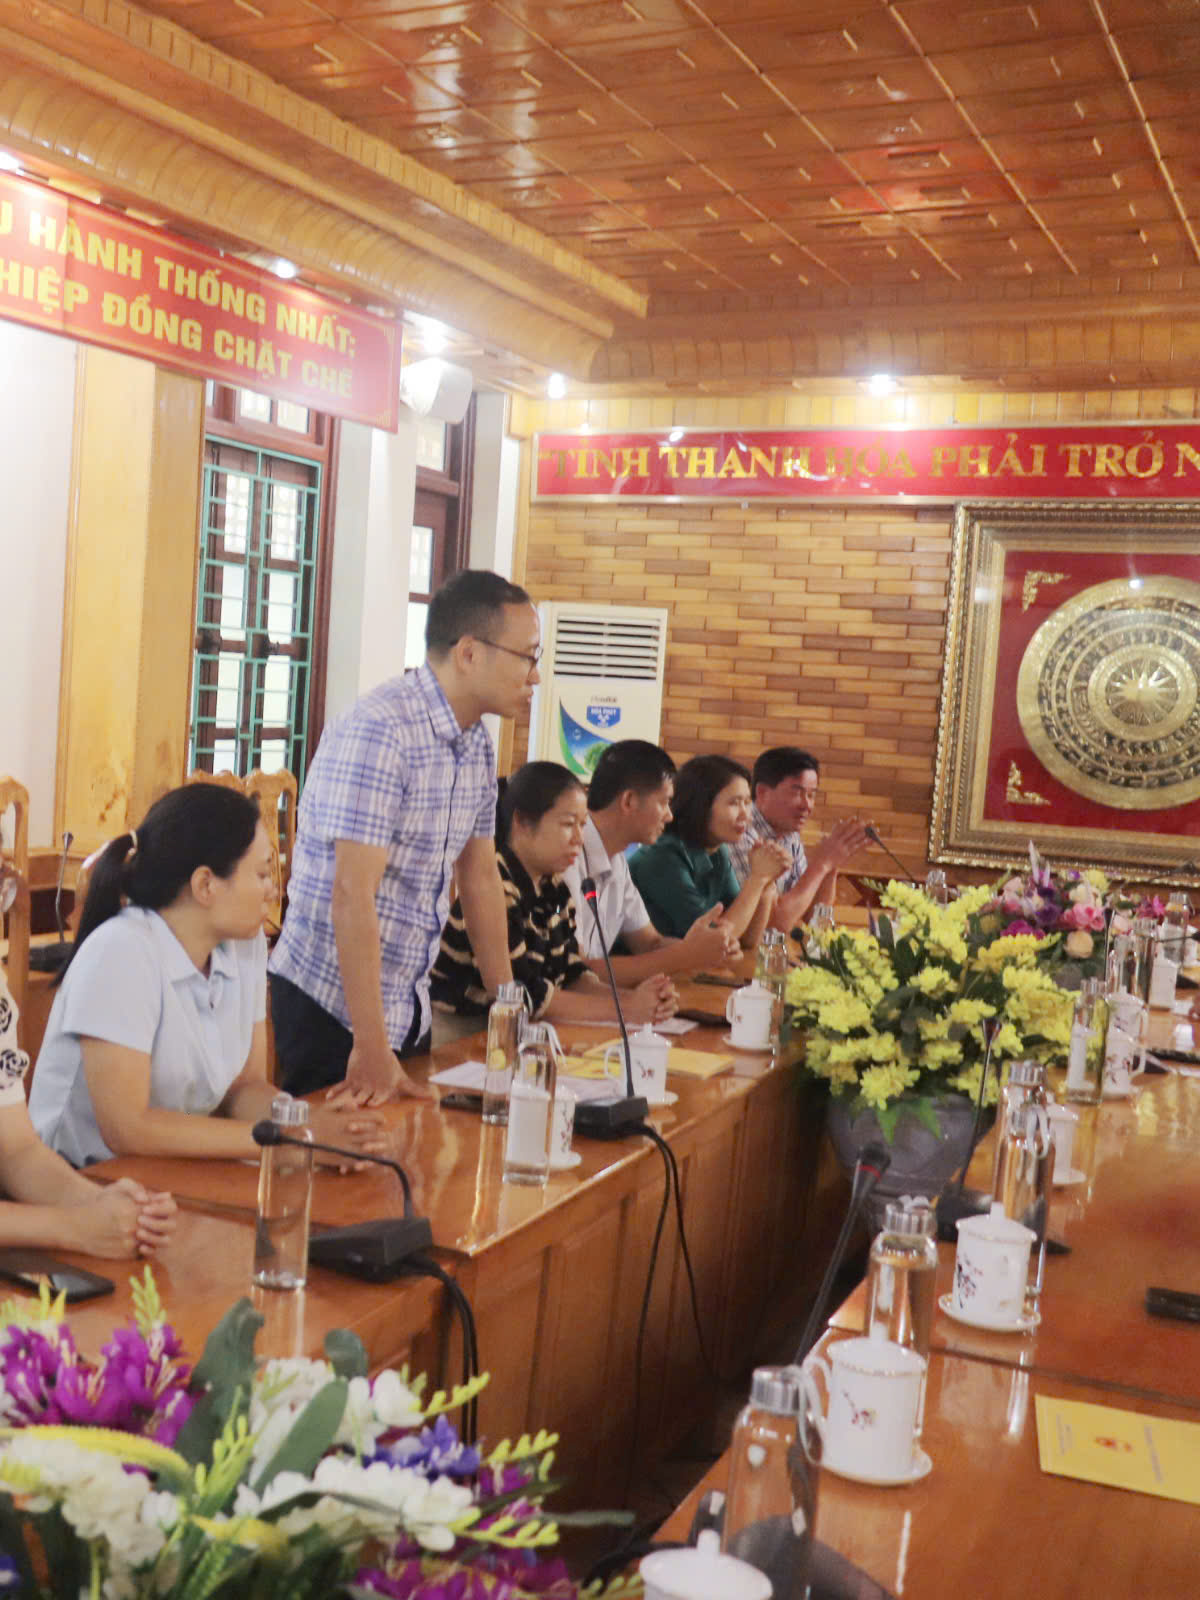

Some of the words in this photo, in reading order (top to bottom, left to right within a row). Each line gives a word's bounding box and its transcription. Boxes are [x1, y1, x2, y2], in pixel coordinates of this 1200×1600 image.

[154, 256, 266, 326] THỐNG
[657, 446, 812, 479] THANH
[824, 436, 918, 479] HÓA
[928, 432, 1048, 478] PHẢI
[1058, 431, 1165, 479] TRỞ
